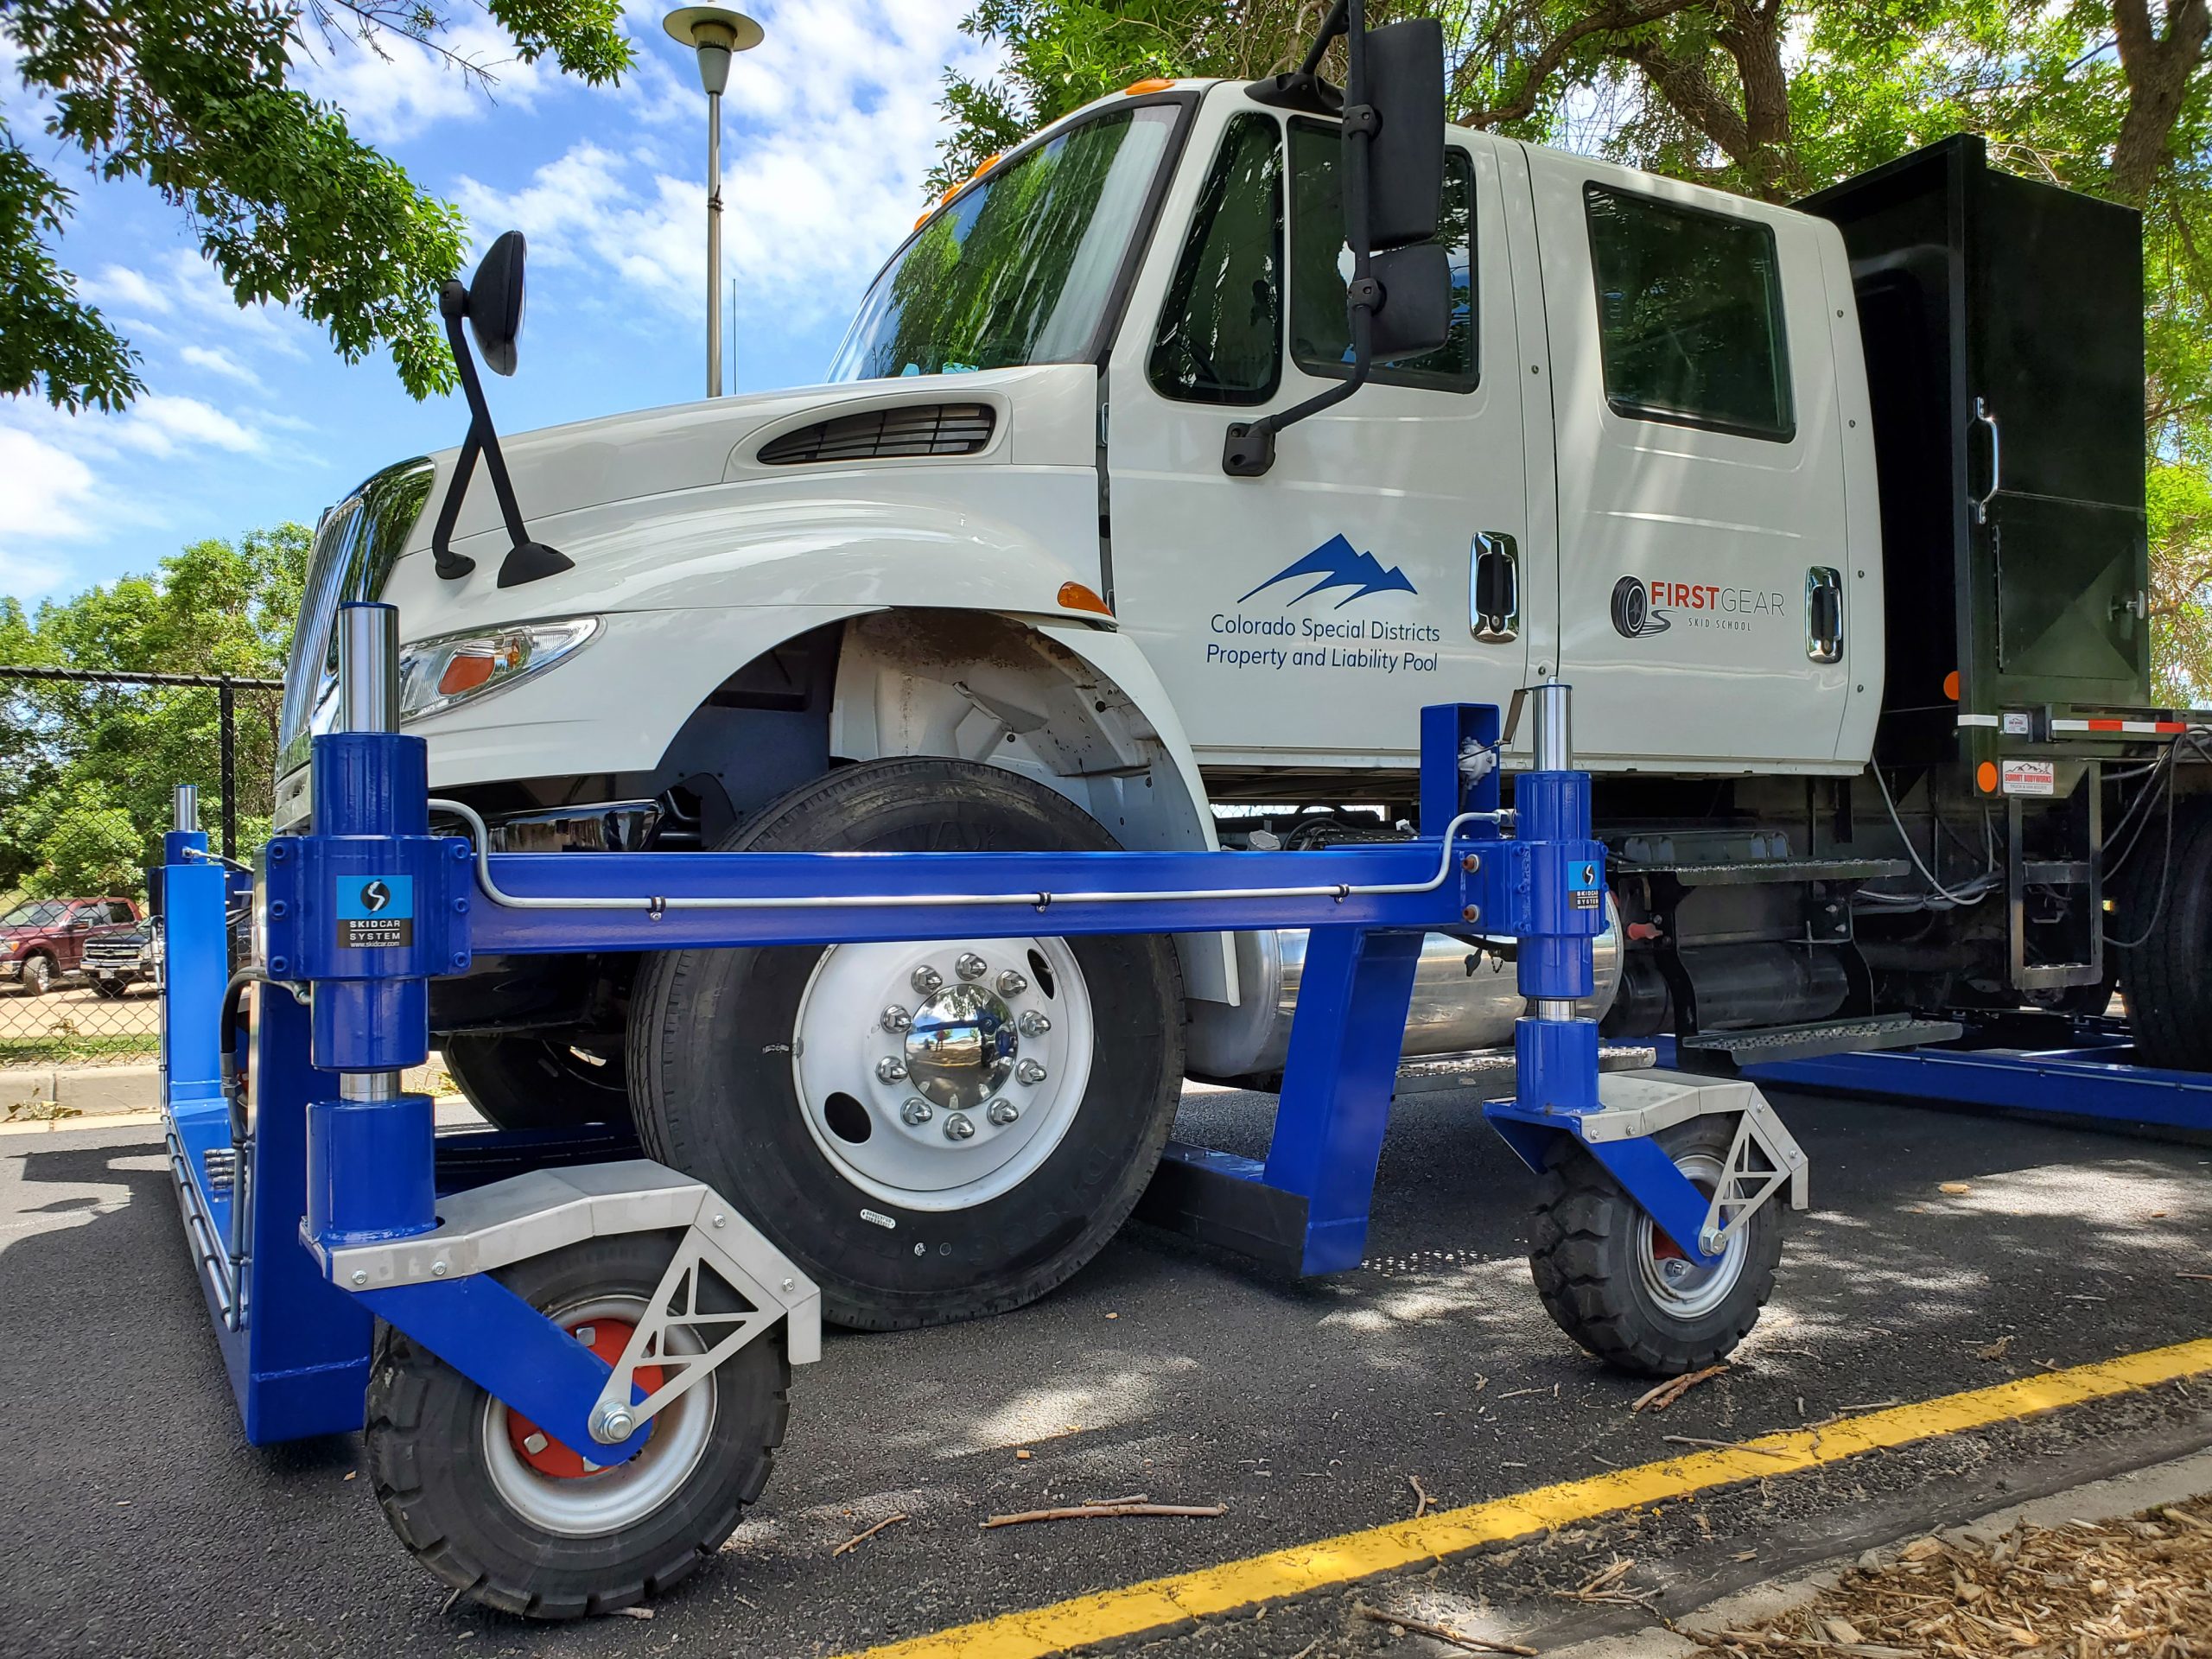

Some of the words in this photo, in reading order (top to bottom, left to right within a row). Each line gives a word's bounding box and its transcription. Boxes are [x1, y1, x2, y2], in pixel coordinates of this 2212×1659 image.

[1211, 613, 1296, 636] Colorado
[1302, 618, 1365, 642] Special
[1371, 620, 1440, 642] Districts
[1688, 617, 1711, 628] SKID
[1716, 620, 1752, 632] SCHOOL
[1206, 644, 1287, 671] Property
[1293, 647, 1326, 667] and
[1332, 648, 1398, 674] Liability
[1403, 652, 1438, 671] Pool
